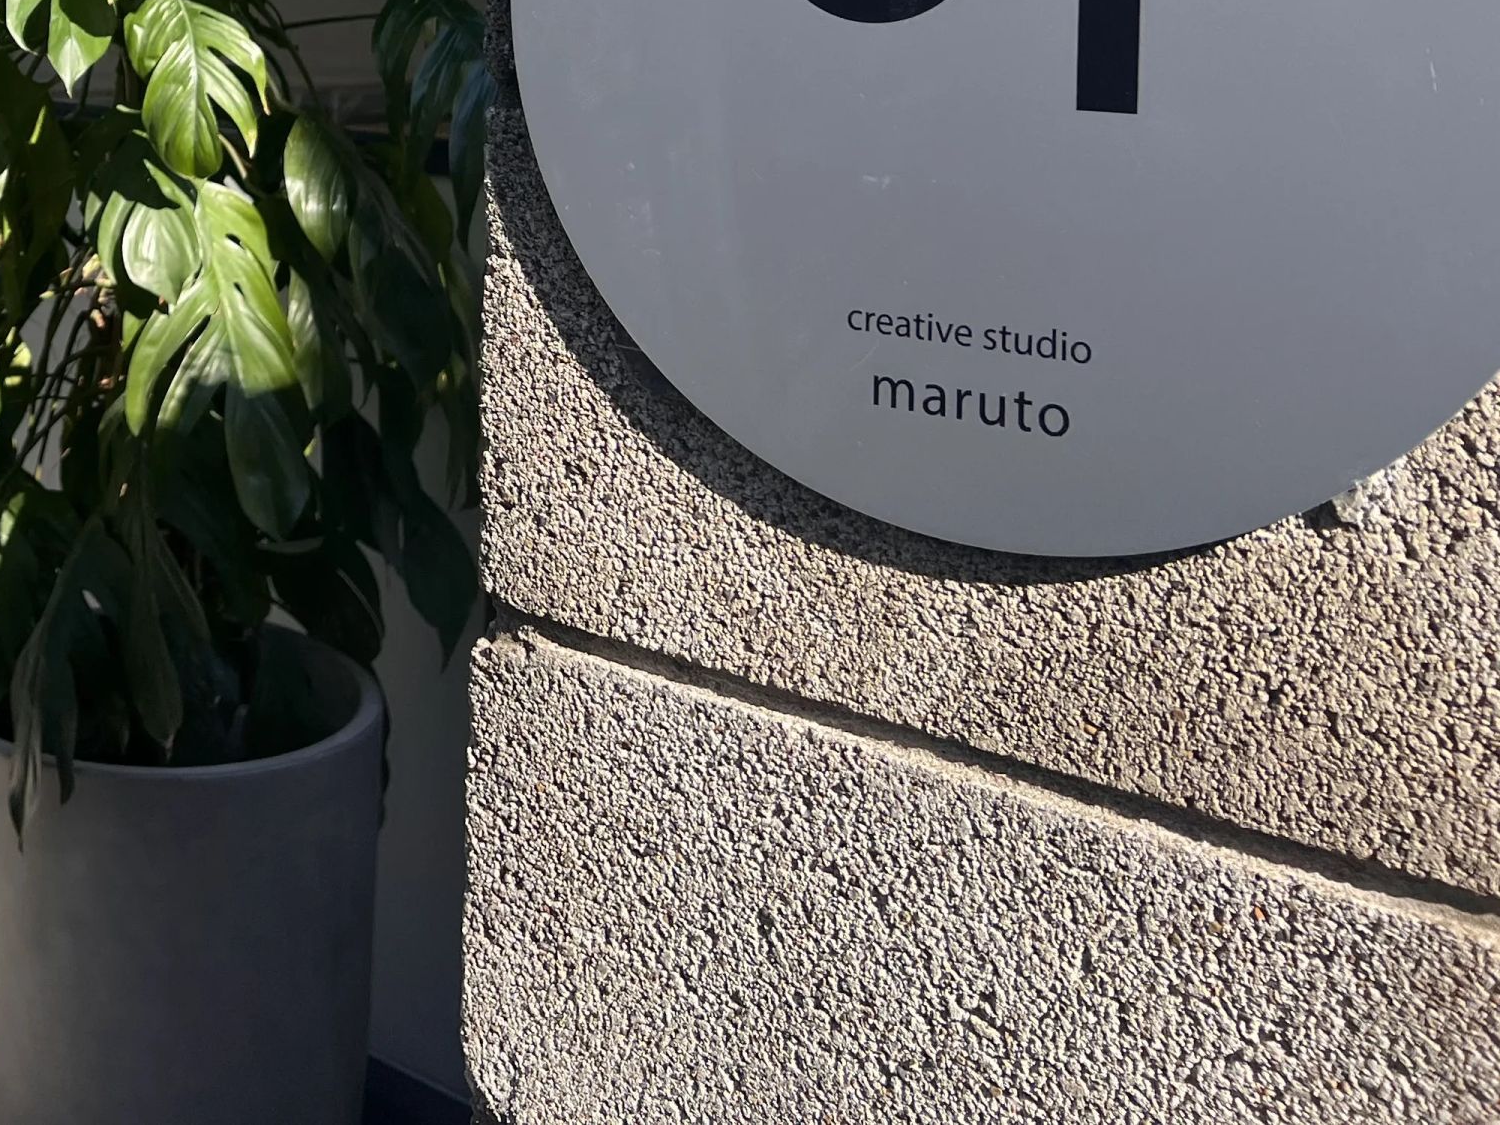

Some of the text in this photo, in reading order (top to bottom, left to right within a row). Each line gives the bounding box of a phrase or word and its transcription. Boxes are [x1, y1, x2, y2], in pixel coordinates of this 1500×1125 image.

[846, 308, 1093, 364] creative studio
[871, 374, 1071, 437] maruto
